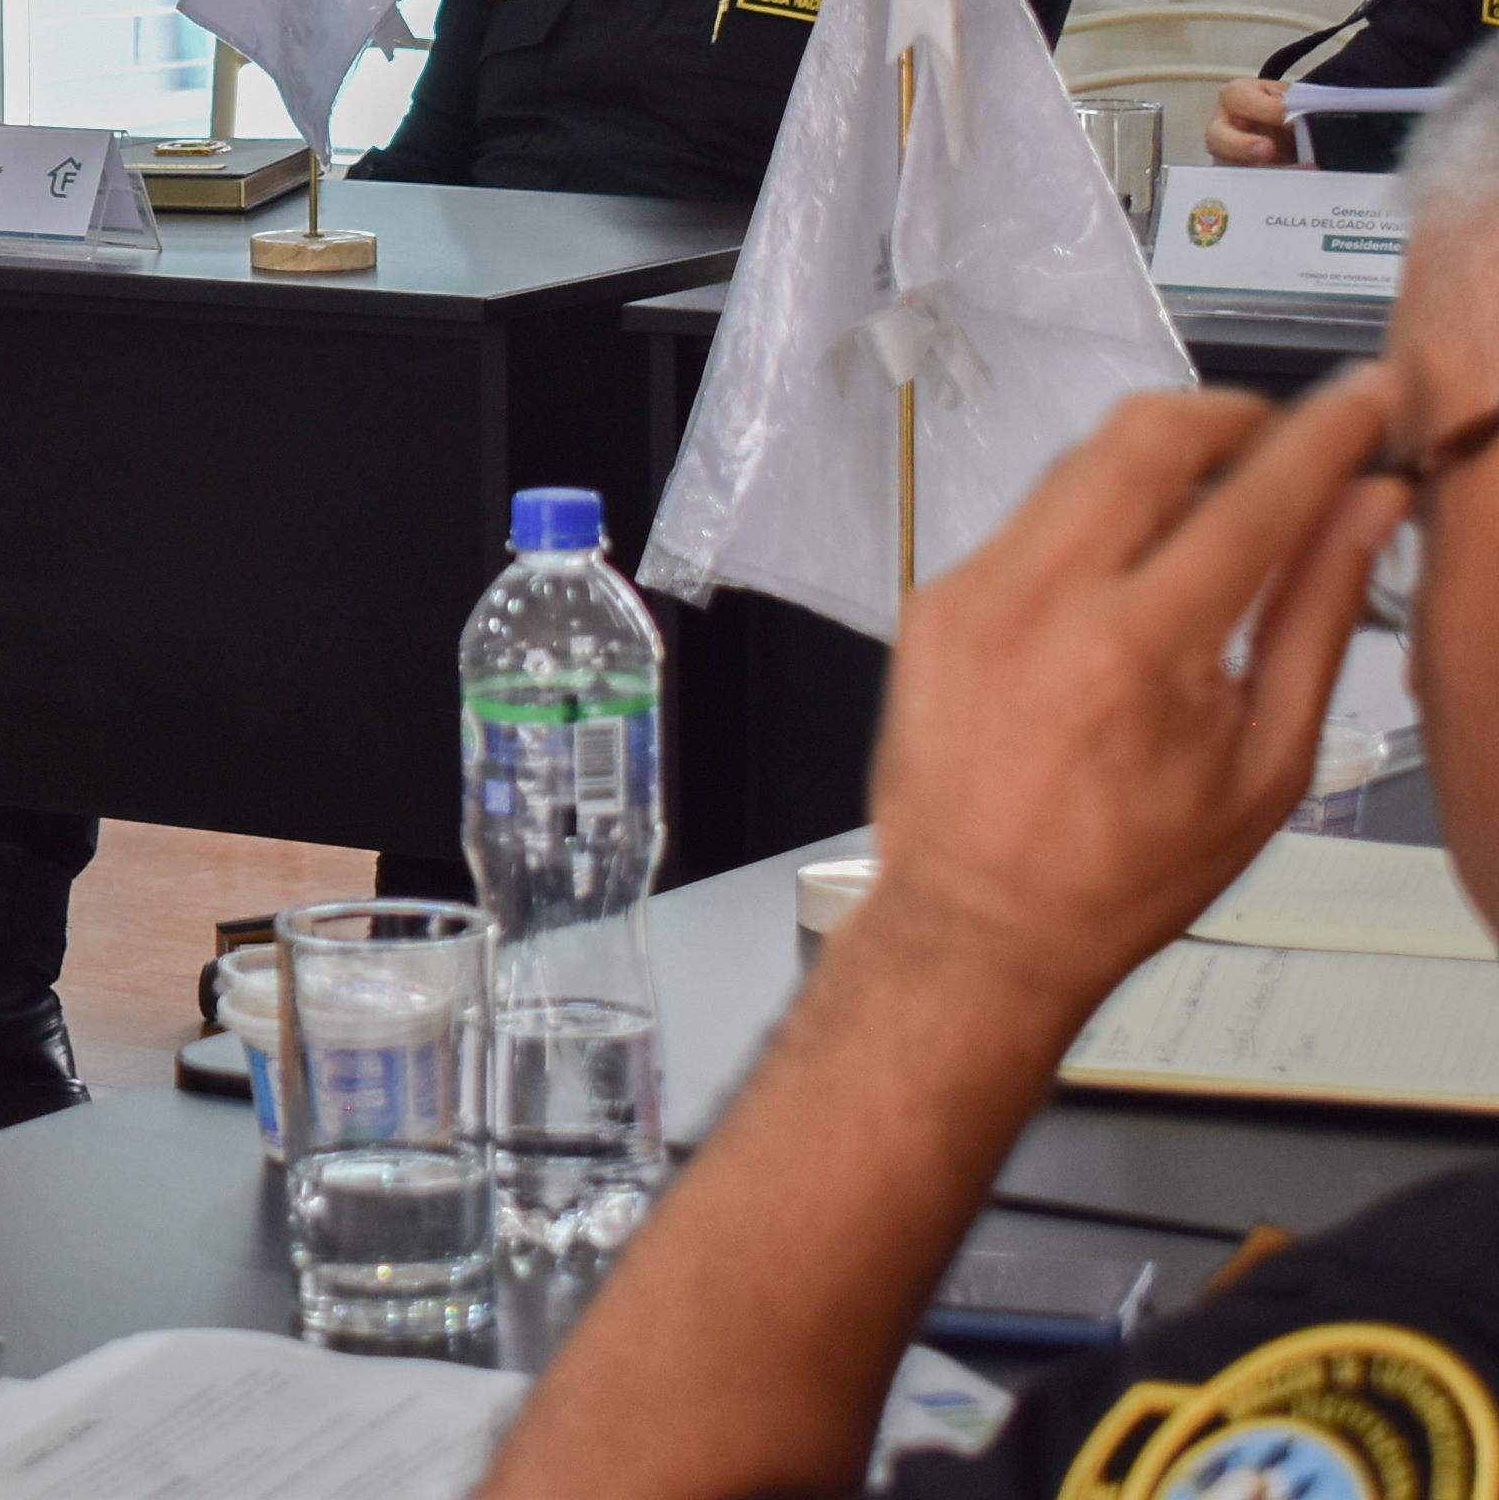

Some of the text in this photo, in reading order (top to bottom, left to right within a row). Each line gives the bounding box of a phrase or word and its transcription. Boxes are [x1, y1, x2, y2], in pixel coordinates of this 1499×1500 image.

[1331, 206, 1382, 219] General
[1265, 216, 1307, 228] CALLA
[1310, 218, 1376, 231] DELGADO
[1331, 239, 1402, 252] Presidente
